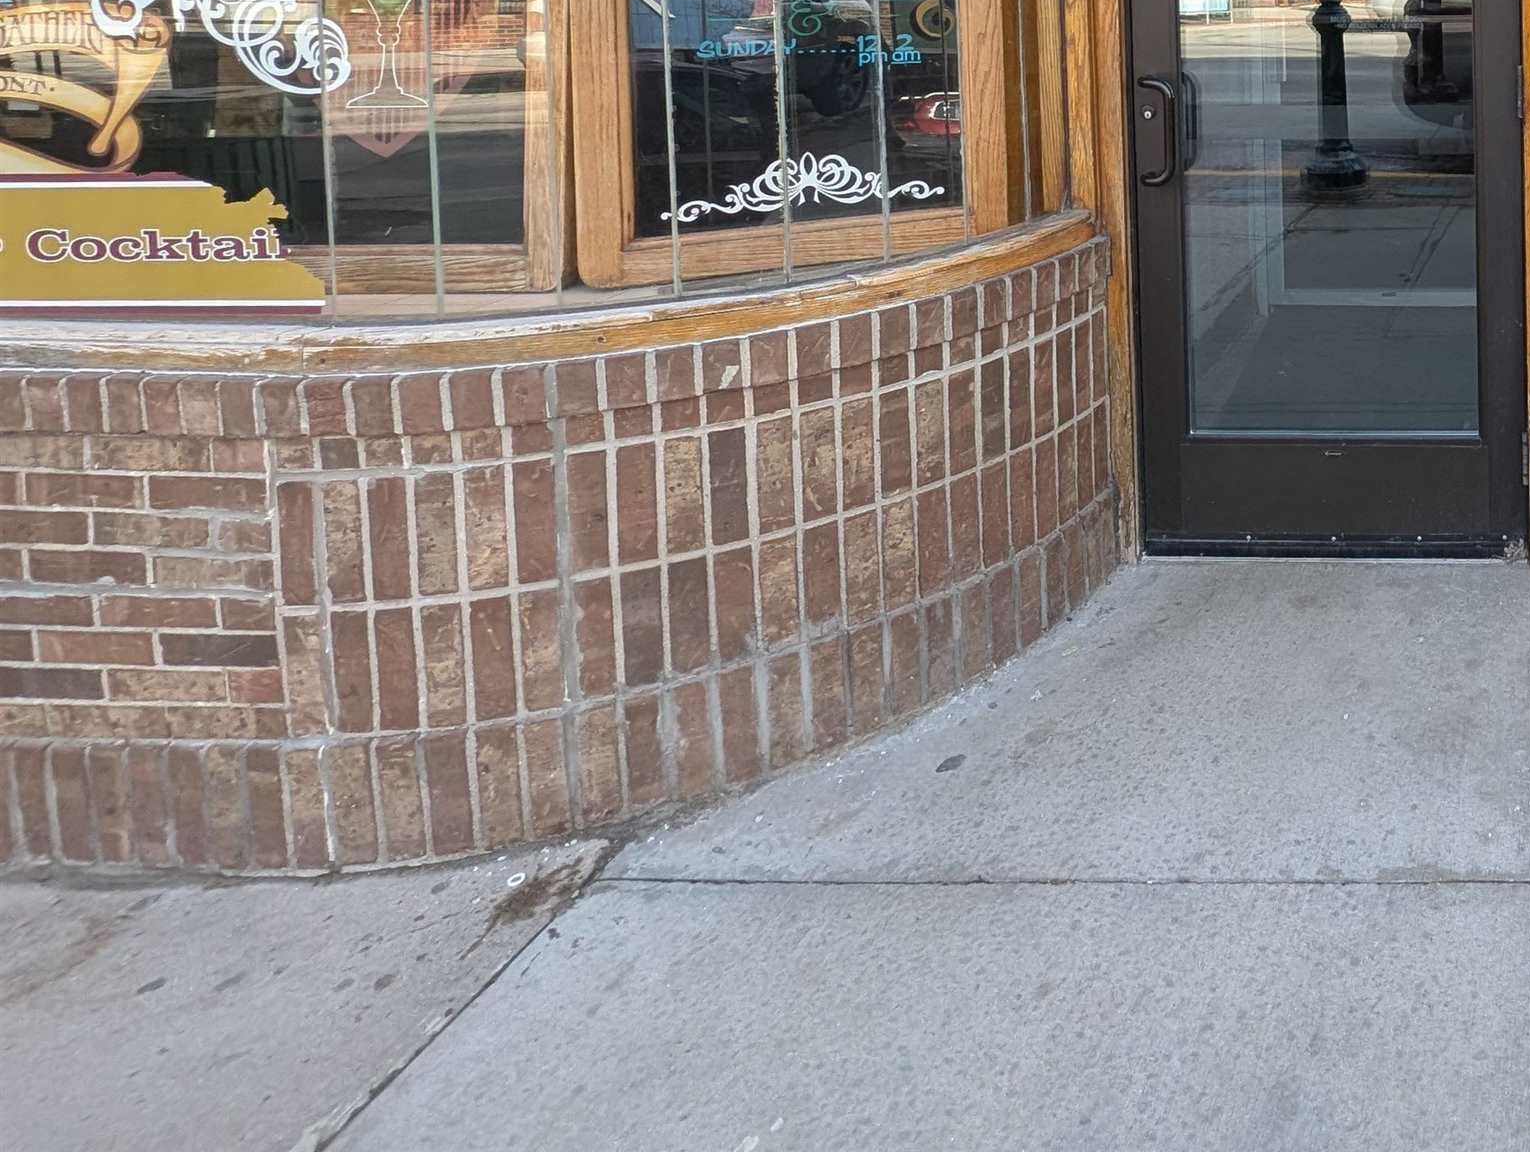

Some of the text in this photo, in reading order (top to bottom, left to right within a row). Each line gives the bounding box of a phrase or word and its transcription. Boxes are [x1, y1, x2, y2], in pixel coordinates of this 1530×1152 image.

[696, 33, 914, 59] SUNDAY 12 2
[858, 49, 921, 67] pm am
